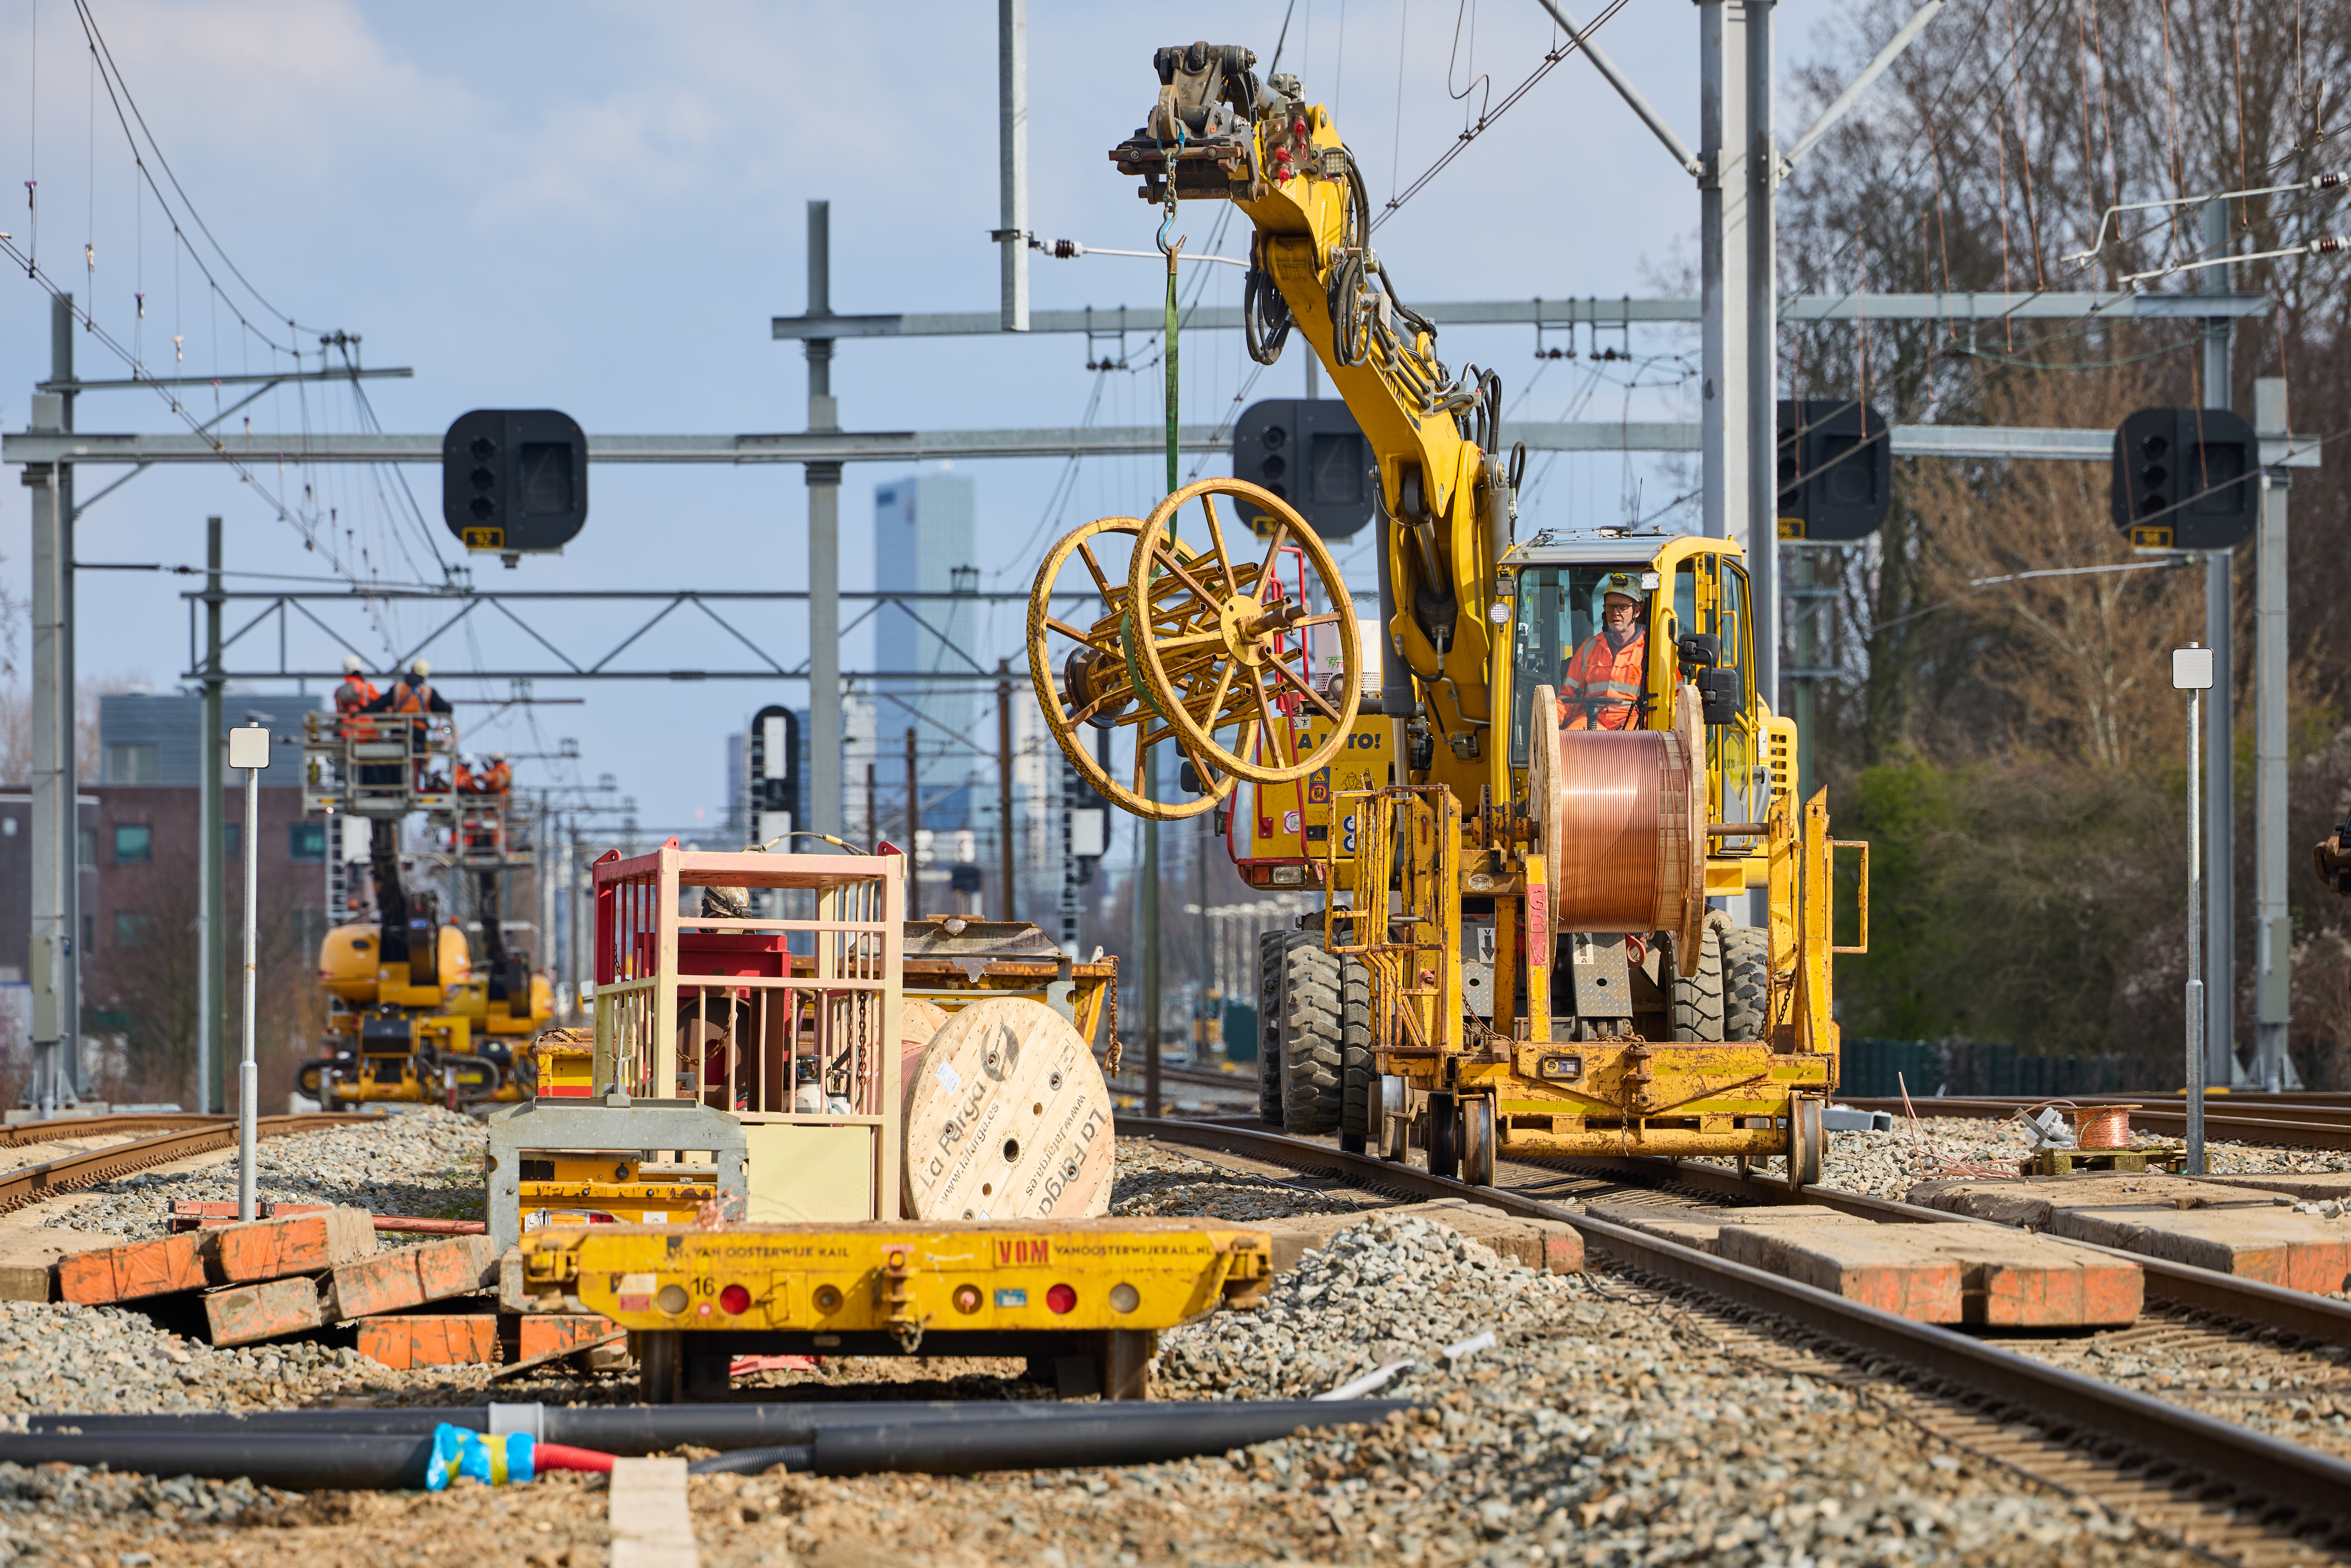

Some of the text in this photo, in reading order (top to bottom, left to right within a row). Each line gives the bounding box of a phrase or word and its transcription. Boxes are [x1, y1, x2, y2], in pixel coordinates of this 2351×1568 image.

[1384, 372, 1405, 410] ATLAS
[474, 531, 492, 546] 92
[919, 1156, 945, 1191] La
[938, 1081, 987, 1157] Farga
[939, 1102, 999, 1205] www.lafarga.es
[1026, 1094, 1086, 1196] www.lafarga.es
[1038, 1107, 1106, 1219] La Farga
[692, 1247, 720, 1257] VAN
[725, 1247, 814, 1257] OOSTERWIJK
[819, 1247, 849, 1257] RAIL
[999, 1240, 1212, 1264] VOM VANOOSTERWIJKRAIL.NL
[692, 1276, 715, 1296] 16
